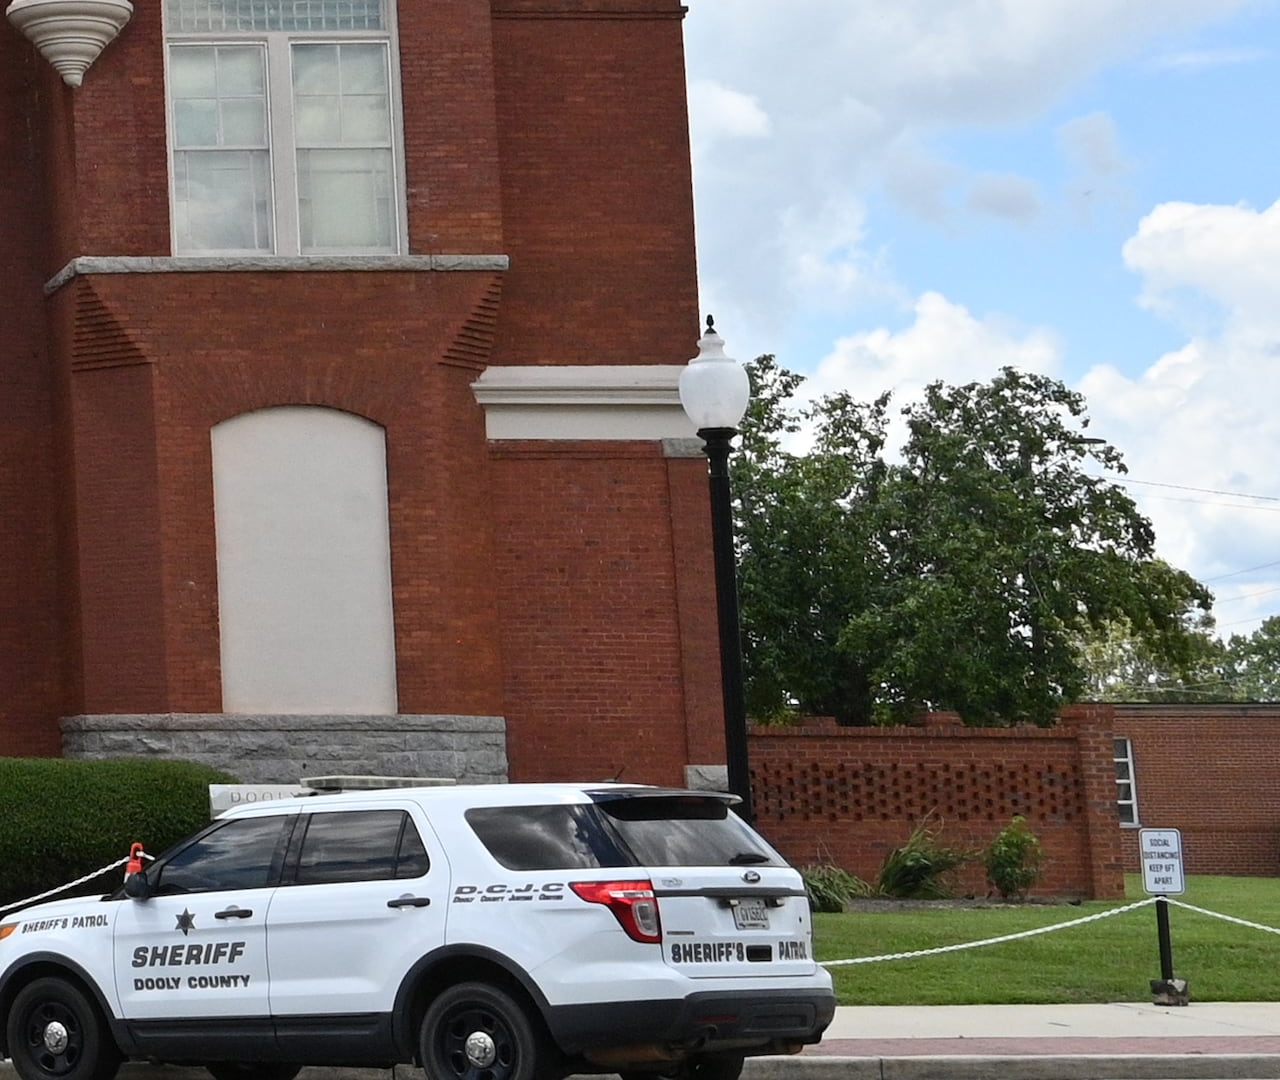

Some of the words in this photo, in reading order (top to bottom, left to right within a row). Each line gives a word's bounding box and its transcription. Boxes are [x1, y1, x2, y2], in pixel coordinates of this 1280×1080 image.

[1149, 839, 1170, 847] SOCIAL
[1143, 851, 1179, 860] DISTANCING
[1149, 864, 1163, 872] KEEP
[1154, 876, 1173, 885] APART
[21, 917, 69, 934] SHERIFF'S
[71, 914, 109, 930] PATROL
[131, 942, 246, 968] SHERIFF
[671, 942, 745, 963] SHERIFF'S
[778, 941, 808, 961] PATROL
[134, 975, 182, 992] DOOLY
[187, 974, 251, 989] COUNTY
